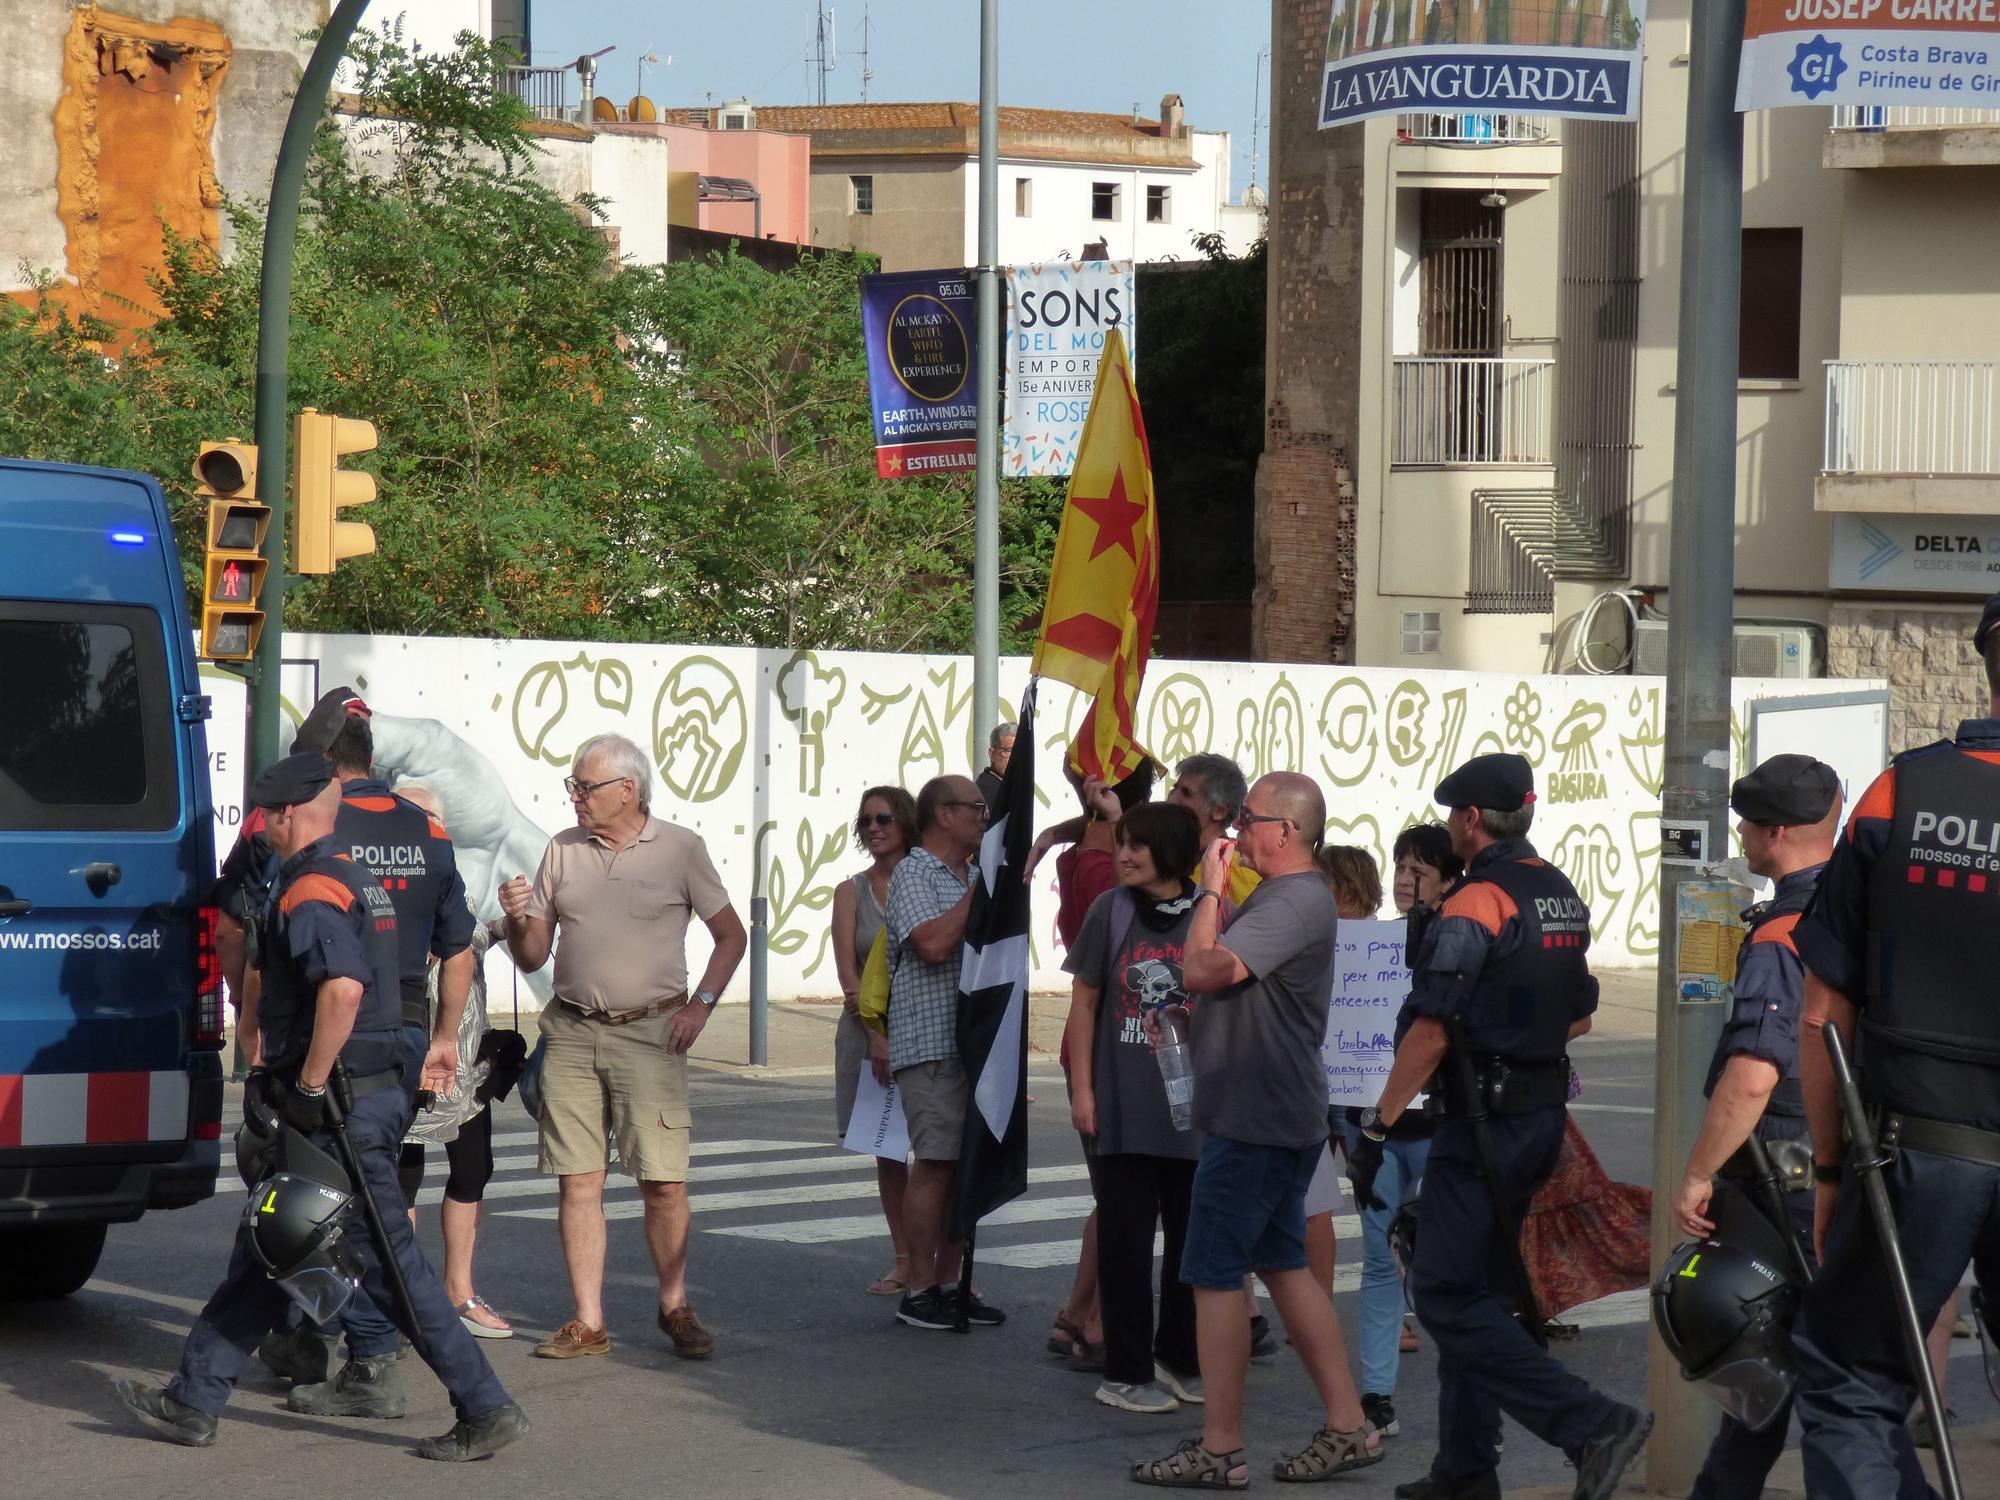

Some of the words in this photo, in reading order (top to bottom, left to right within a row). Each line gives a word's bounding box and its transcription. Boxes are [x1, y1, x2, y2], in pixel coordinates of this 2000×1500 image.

[1785, 0, 1880, 21] JOSEP
[1891, 0, 2000, 22] CARRE
[1861, 45, 1919, 63] Costa
[1927, 47, 1988, 65] Brava
[1330, 78, 1363, 111] LA
[1365, 63, 1617, 105] VANGUARDIA
[1858, 71, 1931, 89] Pirineu
[1939, 73, 1963, 90] de
[939, 284, 967, 297] 05.08
[1019, 288, 1122, 328] SONS
[895, 316, 908, 327] AL
[908, 327, 941, 339] EARTH
[1019, 332, 1057, 352] DEL
[1071, 331, 1104, 350] MO
[912, 340, 944, 352] WIND
[924, 351, 946, 364] FIRE
[902, 363, 963, 379] EXPERIENCE
[1018, 380, 1038, 393] 15e
[883, 425, 898, 436] AL
[899, 421, 941, 434] MCKAY'S
[906, 452, 967, 471] ESTRELLA
[1914, 534, 1982, 553] DELTA
[1914, 559, 1953, 571] DESDE
[1547, 772, 1608, 805] BASURA
[1911, 811, 2000, 853] POLI
[351, 845, 426, 865] POLICIA
[1910, 846, 1971, 867] mossos
[1534, 897, 1586, 920] POLICIA
[1120, 1029, 1135, 1043] NI
